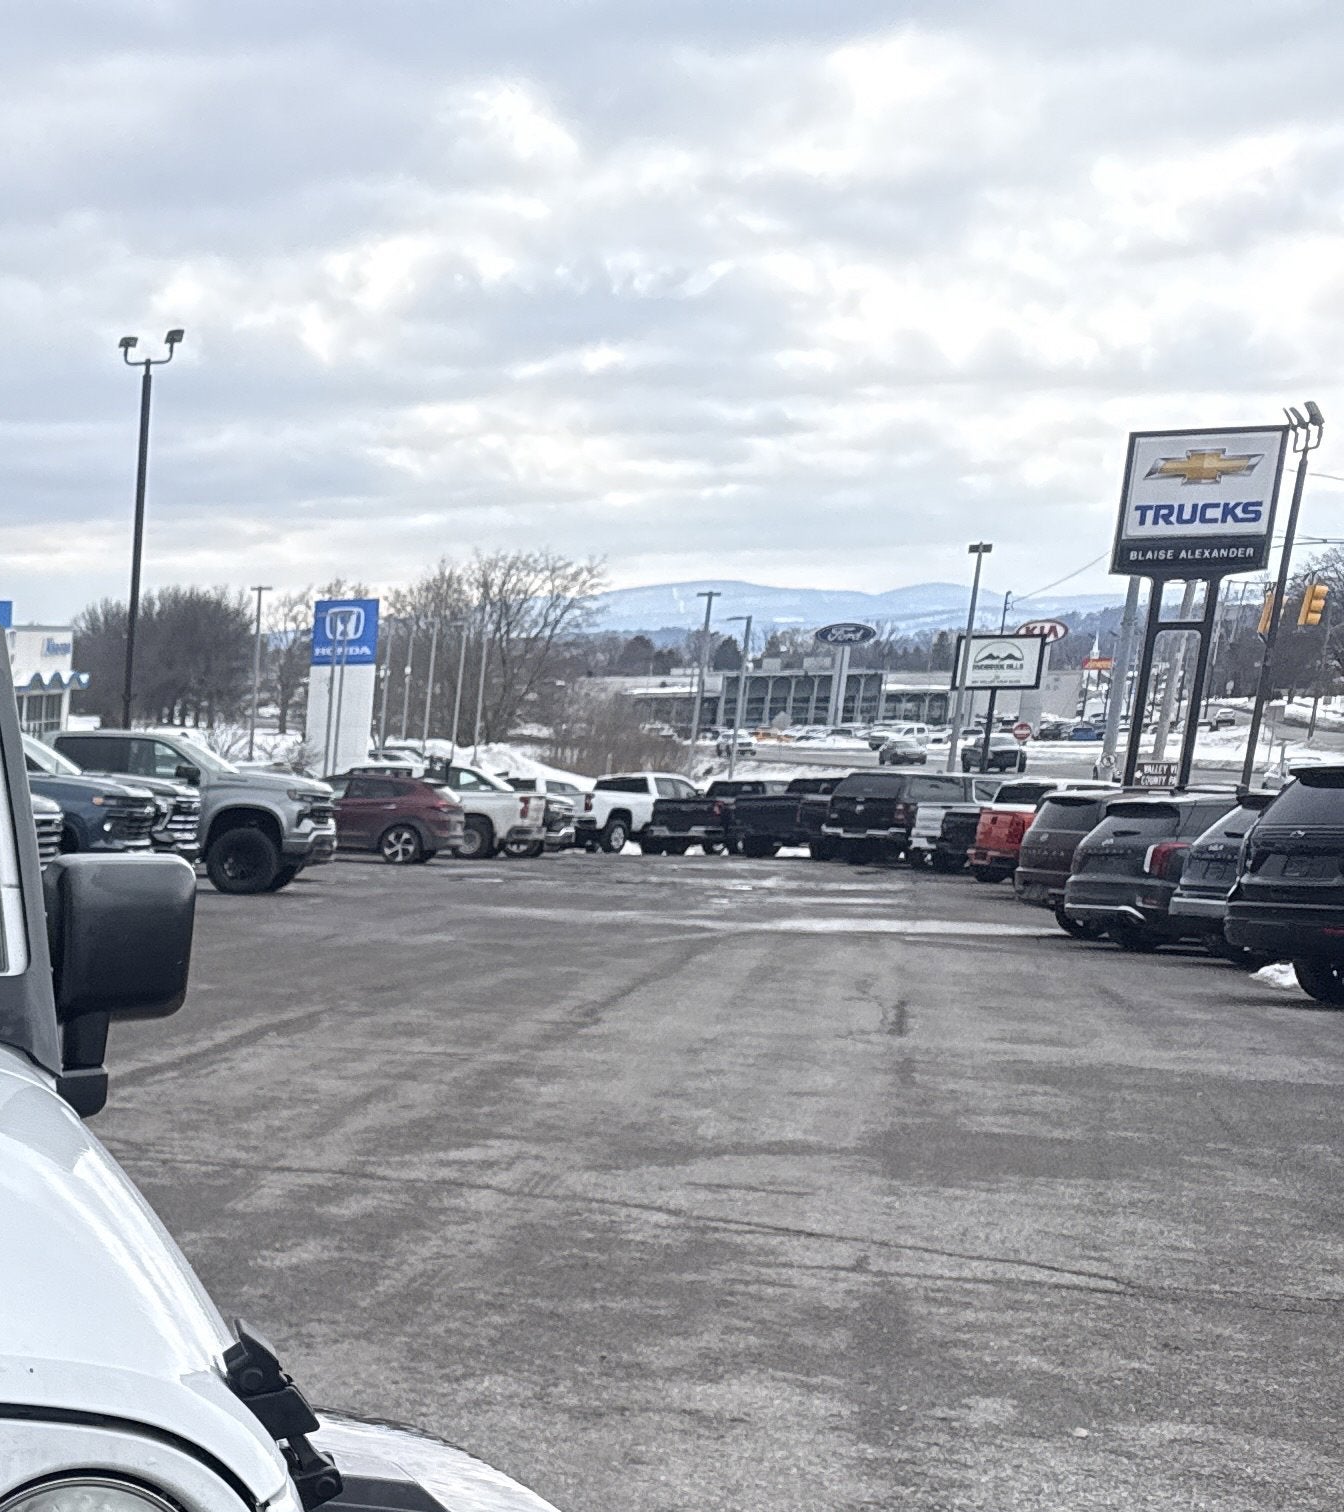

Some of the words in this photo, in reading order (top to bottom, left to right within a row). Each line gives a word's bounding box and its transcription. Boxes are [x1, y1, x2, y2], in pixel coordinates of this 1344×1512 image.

[1135, 501, 1262, 526] TRUCKS
[1129, 549, 1174, 561] BLAISE
[1179, 547, 1254, 560] ALEXANDER
[827, 626, 865, 642] Ford
[1025, 625, 1059, 638] KIA
[1144, 764, 1168, 775] VALLEY
